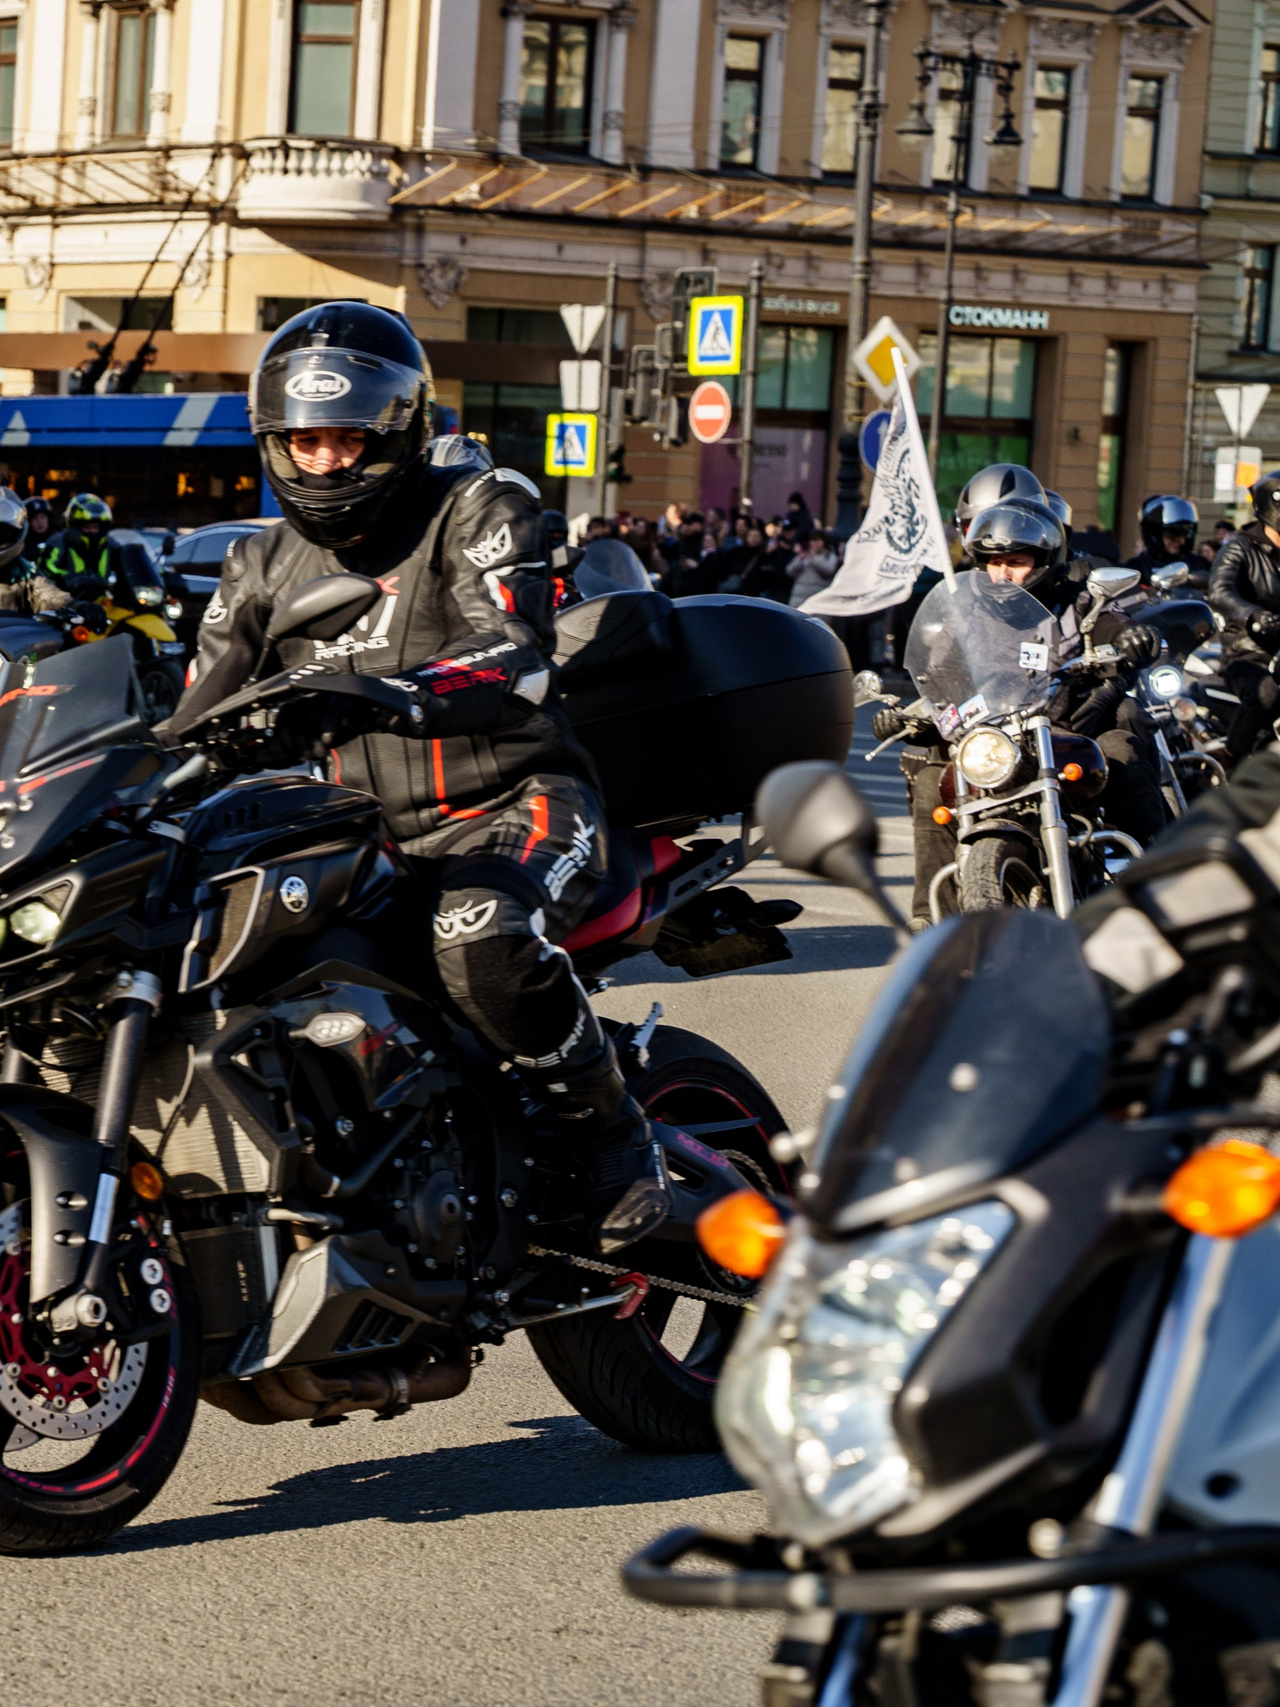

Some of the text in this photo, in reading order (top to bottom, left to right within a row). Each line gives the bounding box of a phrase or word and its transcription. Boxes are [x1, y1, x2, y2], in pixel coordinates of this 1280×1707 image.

[949, 305, 1049, 330] СТОКМАНН
[293, 373, 341, 393] Arai
[314, 636, 390, 661] RACING
[430, 667, 507, 695] BERIK
[543, 812, 596, 902] BERIK
